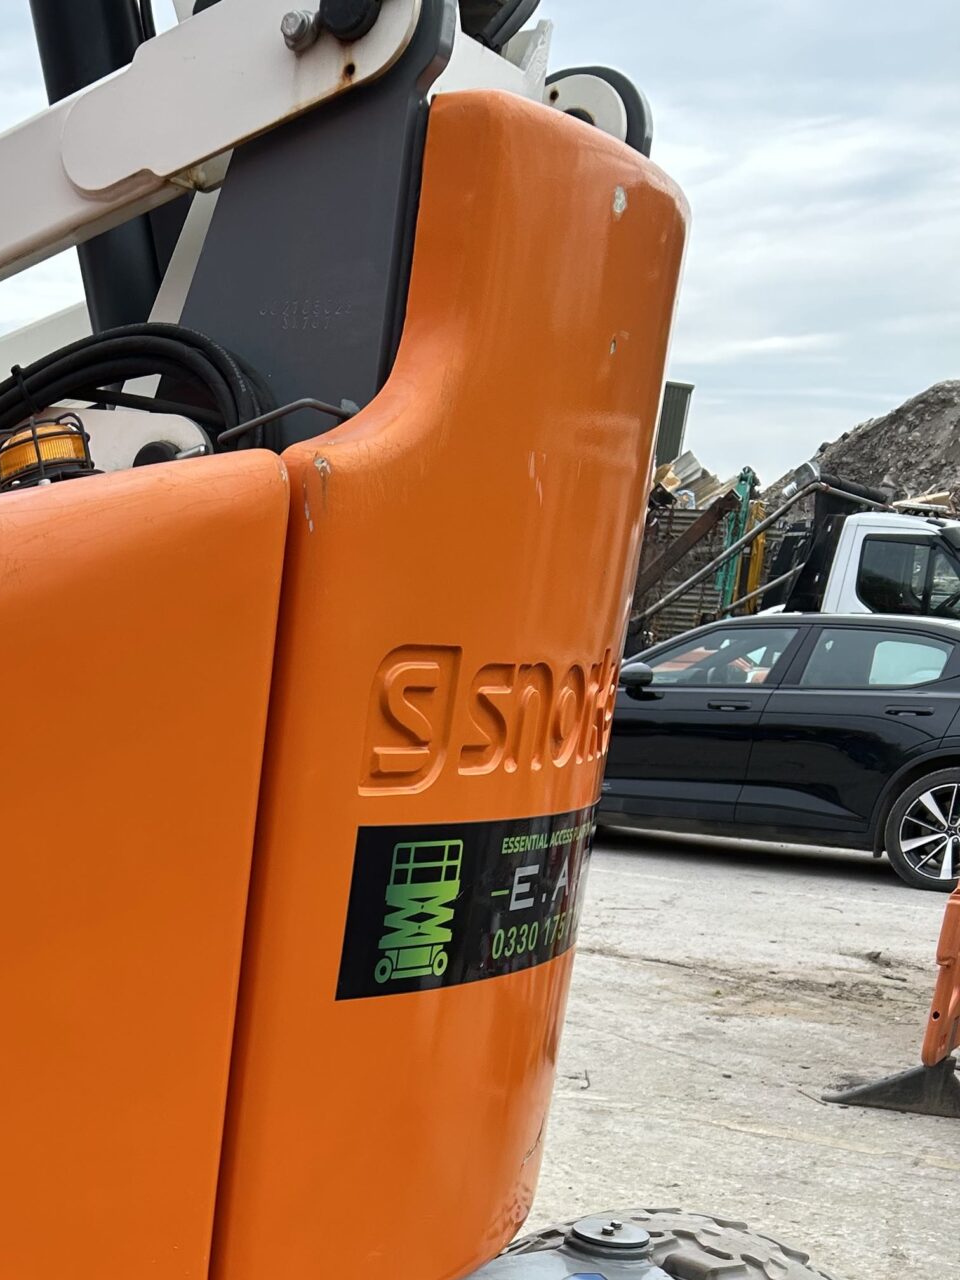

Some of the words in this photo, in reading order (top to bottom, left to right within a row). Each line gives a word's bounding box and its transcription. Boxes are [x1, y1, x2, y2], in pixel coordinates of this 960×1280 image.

[458, 649, 617, 776] snork
[501, 830, 548, 855] ESSENTIAL
[549, 827, 574, 848] ACCESS
[492, 921, 539, 960] 0330
[544, 913, 566, 946] 175
